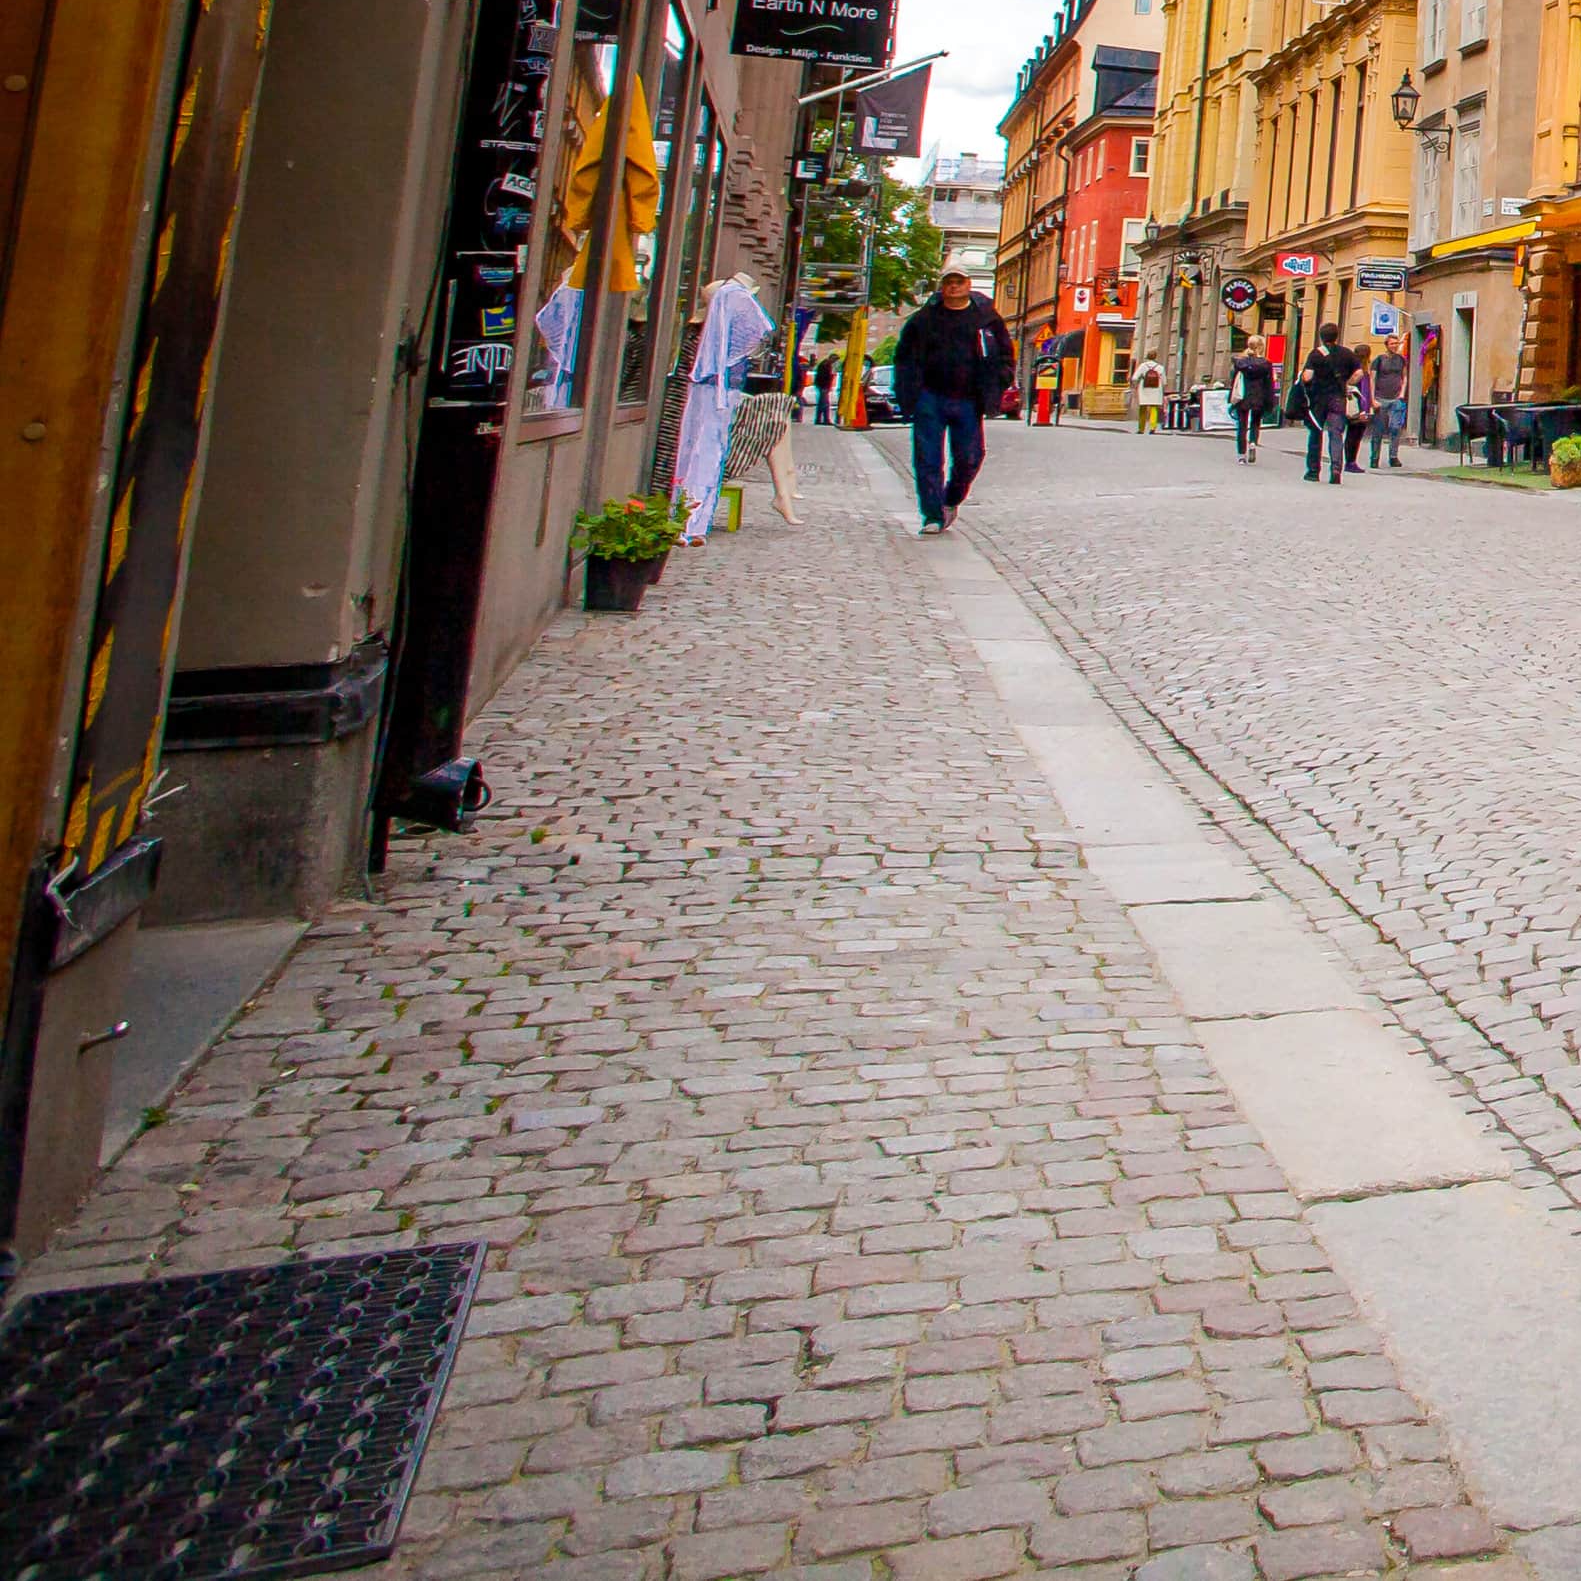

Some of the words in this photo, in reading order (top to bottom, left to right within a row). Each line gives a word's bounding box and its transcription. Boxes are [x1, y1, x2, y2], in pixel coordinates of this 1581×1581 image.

[830, 1, 879, 20] More
[746, 43, 783, 57] Design
[826, 51, 872, 64] Funktion
